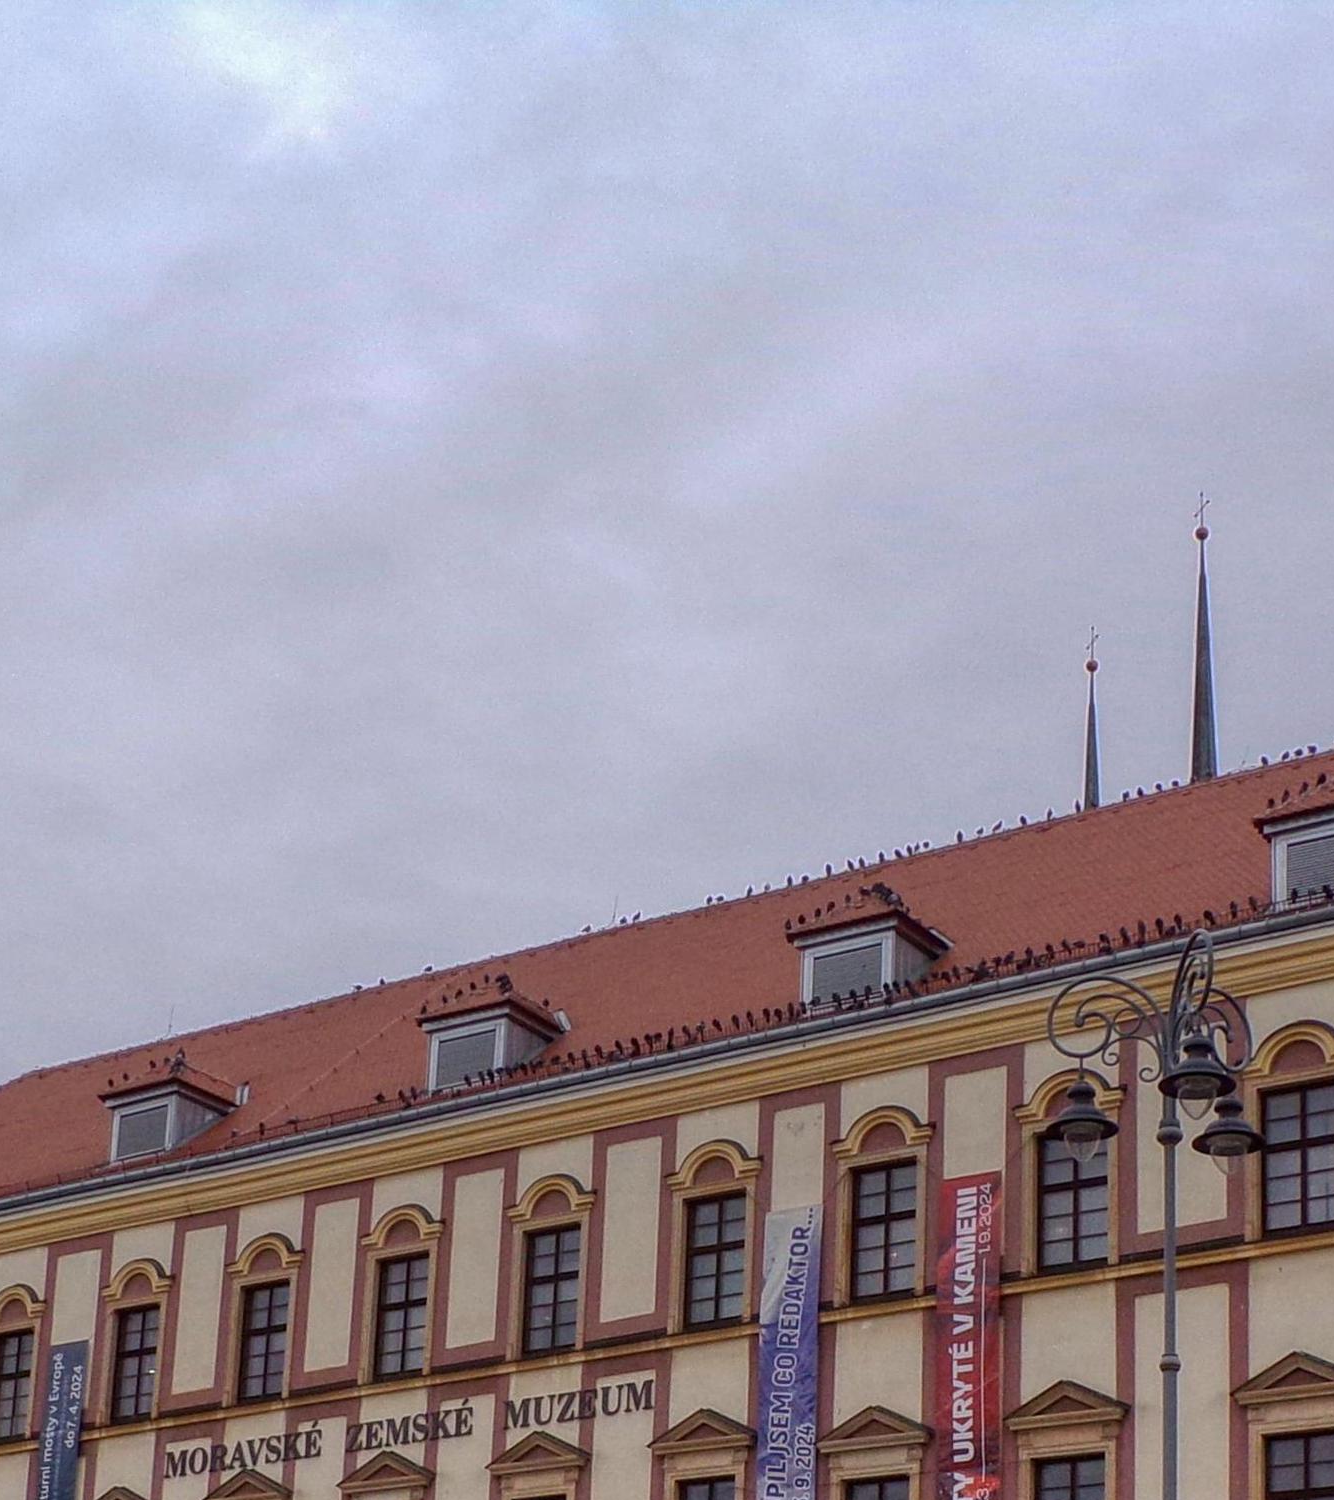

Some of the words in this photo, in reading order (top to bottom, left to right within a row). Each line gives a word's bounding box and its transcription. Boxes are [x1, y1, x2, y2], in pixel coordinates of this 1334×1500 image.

[953, 1187, 978, 1305] KAMENI
[953, 1314, 975, 1334] V
[771, 1355, 795, 1387] CO
[49, 1405, 58, 1416] v
[948, 1341, 975, 1463] UKRYTÉ
[43, 1417, 59, 1463] mosty
[64, 1430, 76, 1449] do
[163, 1420, 322, 1479] MORAVSKÉ
[345, 1398, 474, 1452] ZEMSKÉ
[503, 1379, 655, 1430] MUZEUM
[767, 1393, 793, 1460] JSEM
